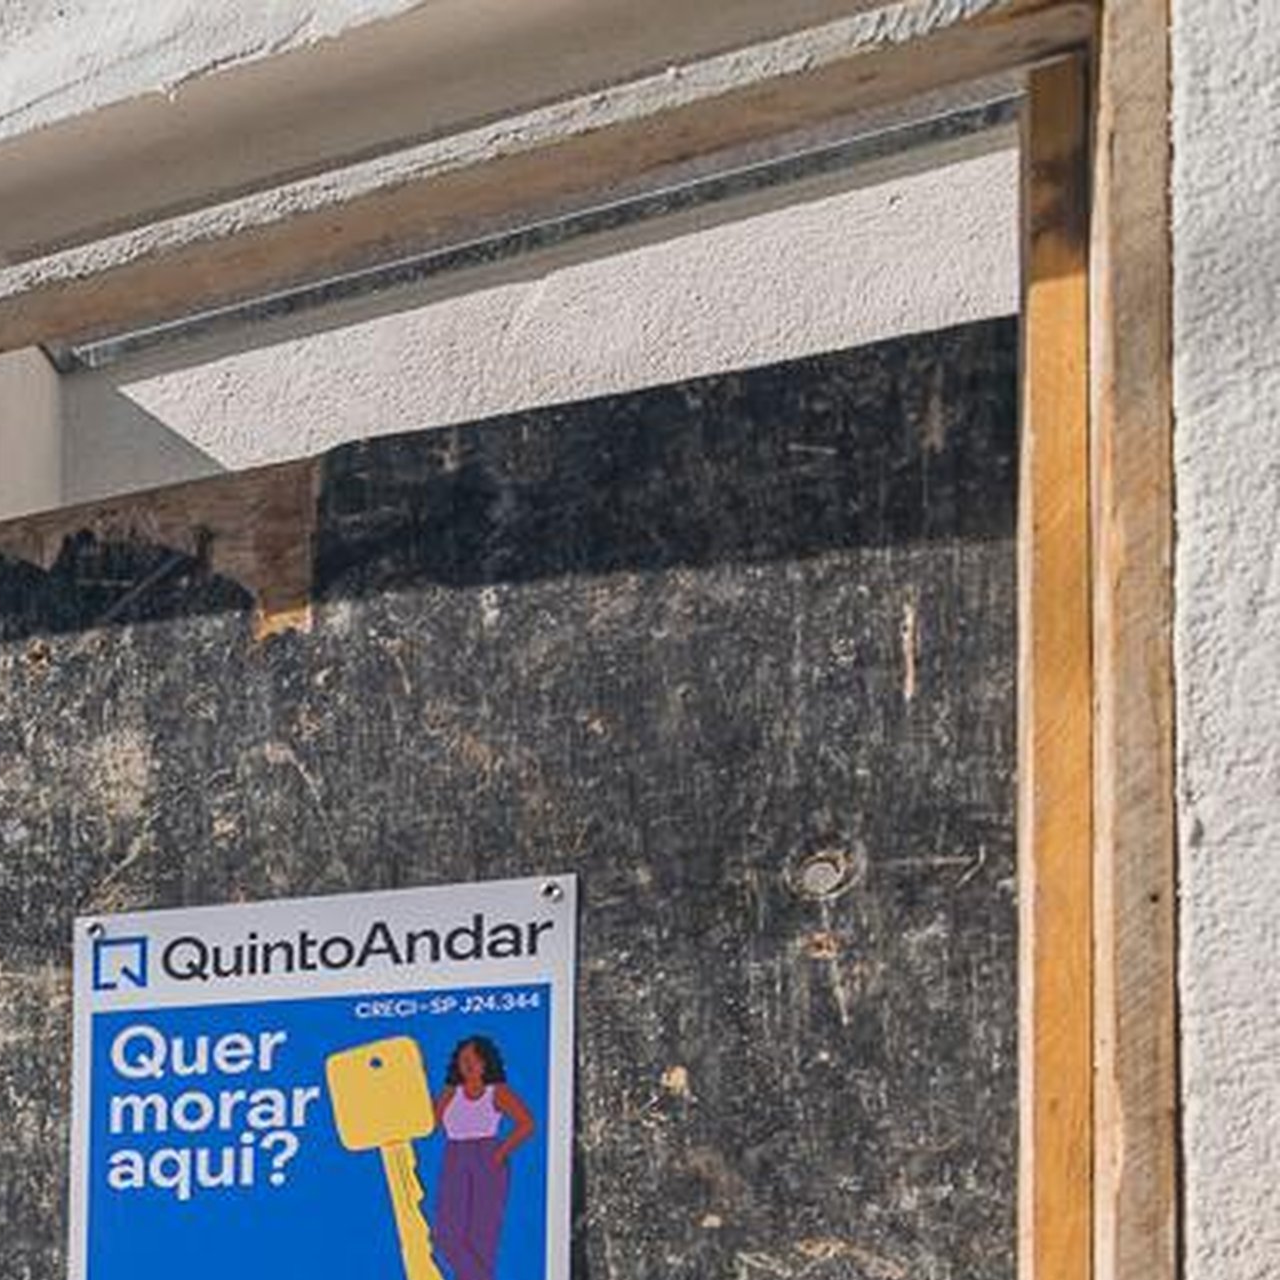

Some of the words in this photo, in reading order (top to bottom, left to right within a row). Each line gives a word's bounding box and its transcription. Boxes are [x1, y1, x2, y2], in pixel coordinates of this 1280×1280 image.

[161, 914, 555, 982] QuintoAndar
[109, 1024, 288, 1080] Quer
[108, 1084, 321, 1135] morar
[106, 1130, 301, 1201] aqui?
